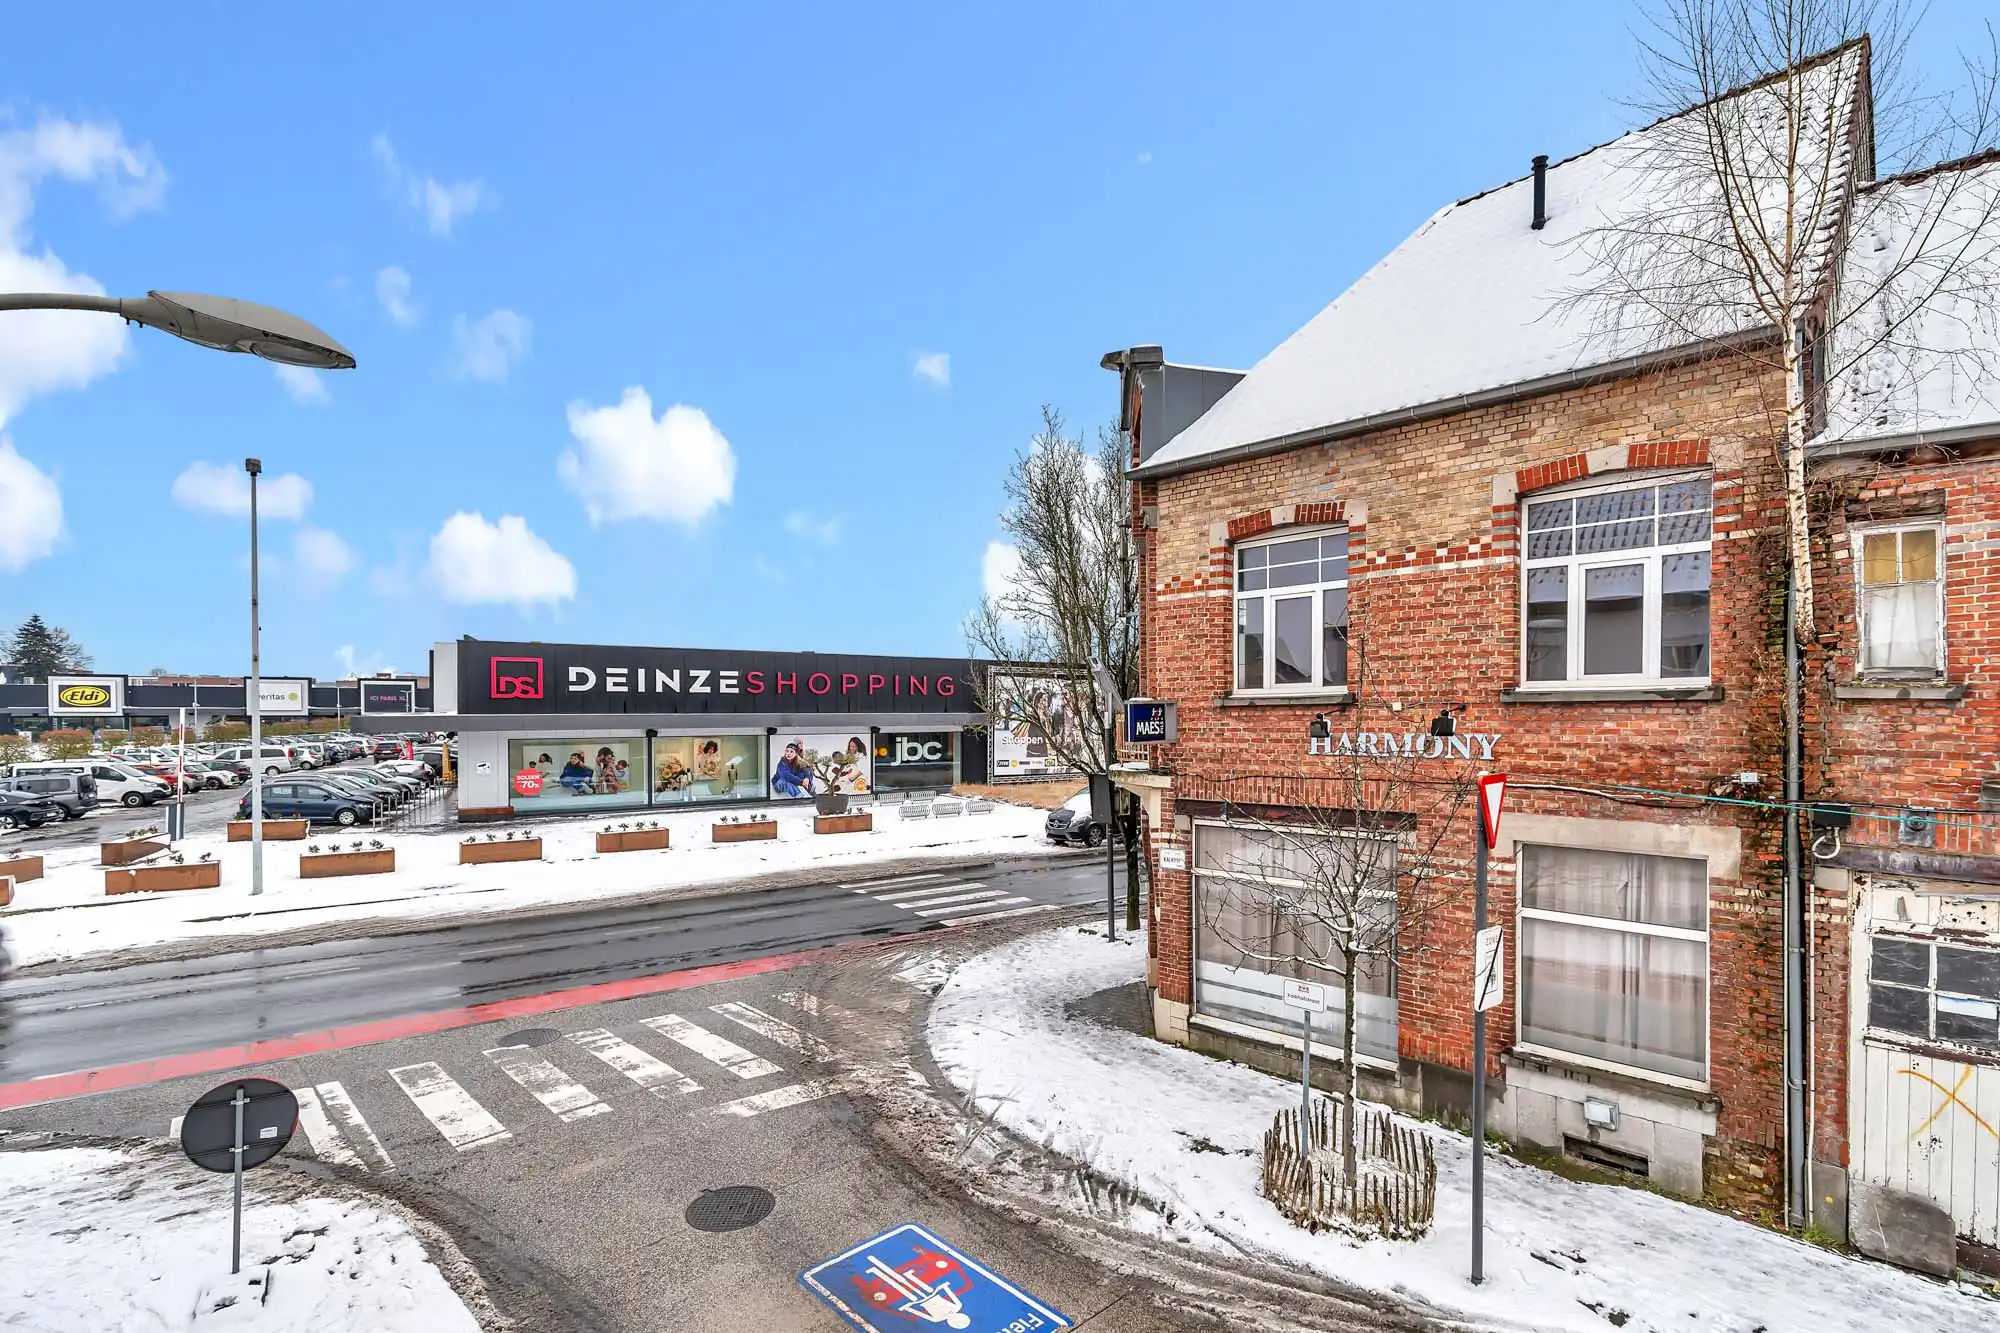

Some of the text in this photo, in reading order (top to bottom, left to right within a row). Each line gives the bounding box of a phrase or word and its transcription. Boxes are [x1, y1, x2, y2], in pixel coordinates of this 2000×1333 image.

[69, 689, 100, 701] Eldi
[1136, 720, 1160, 735] MAES
[1001, 735, 1043, 748] Shoppen
[1308, 732, 1502, 761] HARMONY
[890, 736, 943, 767] jbc
